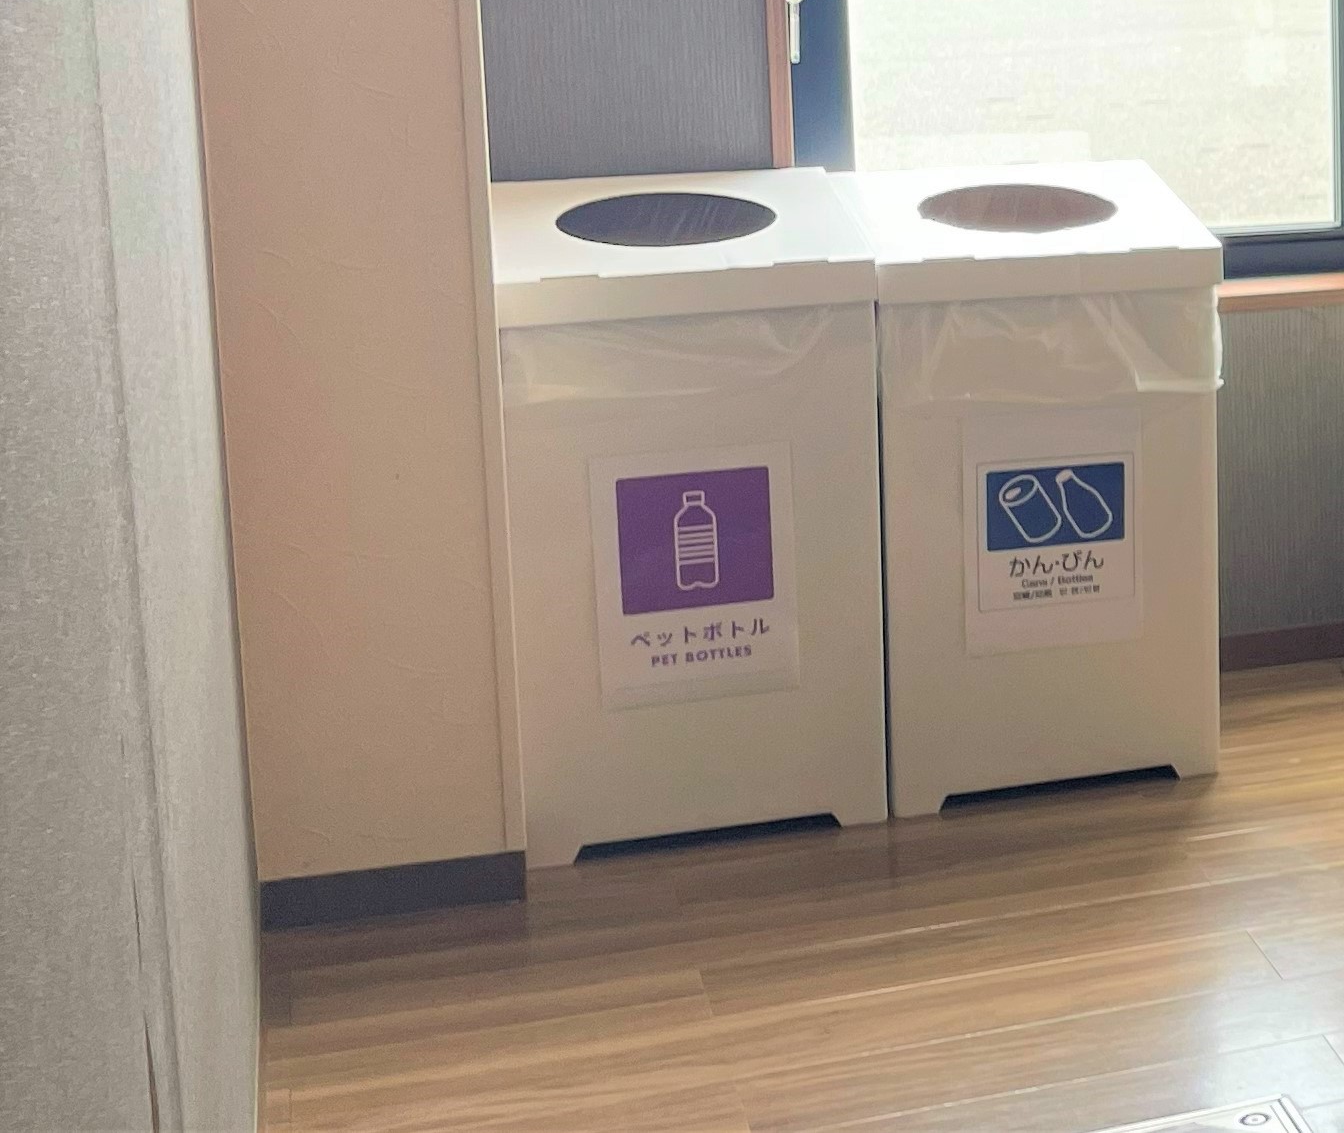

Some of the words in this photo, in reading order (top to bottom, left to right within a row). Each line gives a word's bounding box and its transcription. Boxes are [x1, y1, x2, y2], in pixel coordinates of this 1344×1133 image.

[1009, 549, 1104, 578] かん・びん
[631, 618, 770, 646] ペットボトル
[651, 654, 678, 667] PET
[686, 645, 752, 662] BOTTLES
